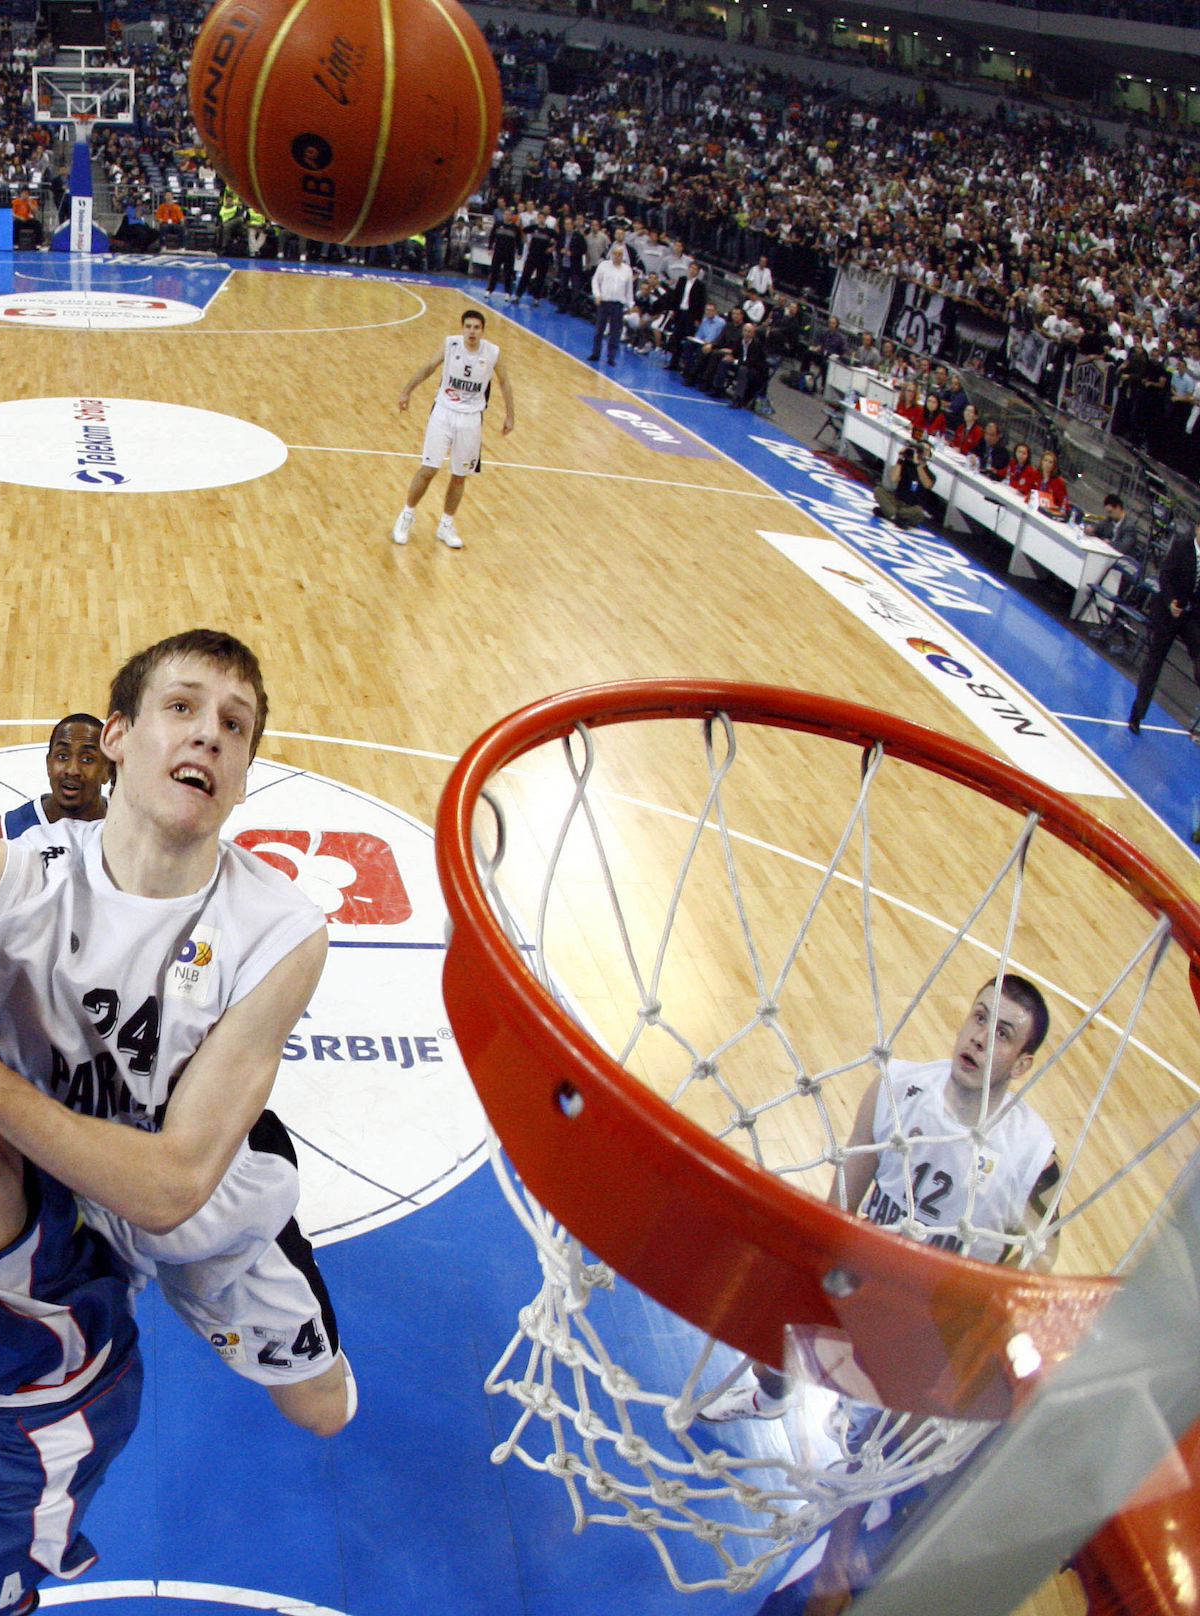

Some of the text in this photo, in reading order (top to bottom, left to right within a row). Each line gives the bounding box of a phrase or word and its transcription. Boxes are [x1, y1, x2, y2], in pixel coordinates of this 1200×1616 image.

[302, 175, 336, 229] NLB
[464, 365, 473, 377] 5
[75, 425, 117, 466] Telekom
[786, 489, 993, 615] ARENA
[966, 682, 1048, 737] NLB
[174, 965, 200, 983] NLB
[82, 988, 162, 1077] 24
[903, 1162, 954, 1220] 12
[257, 1317, 326, 1369] 24
